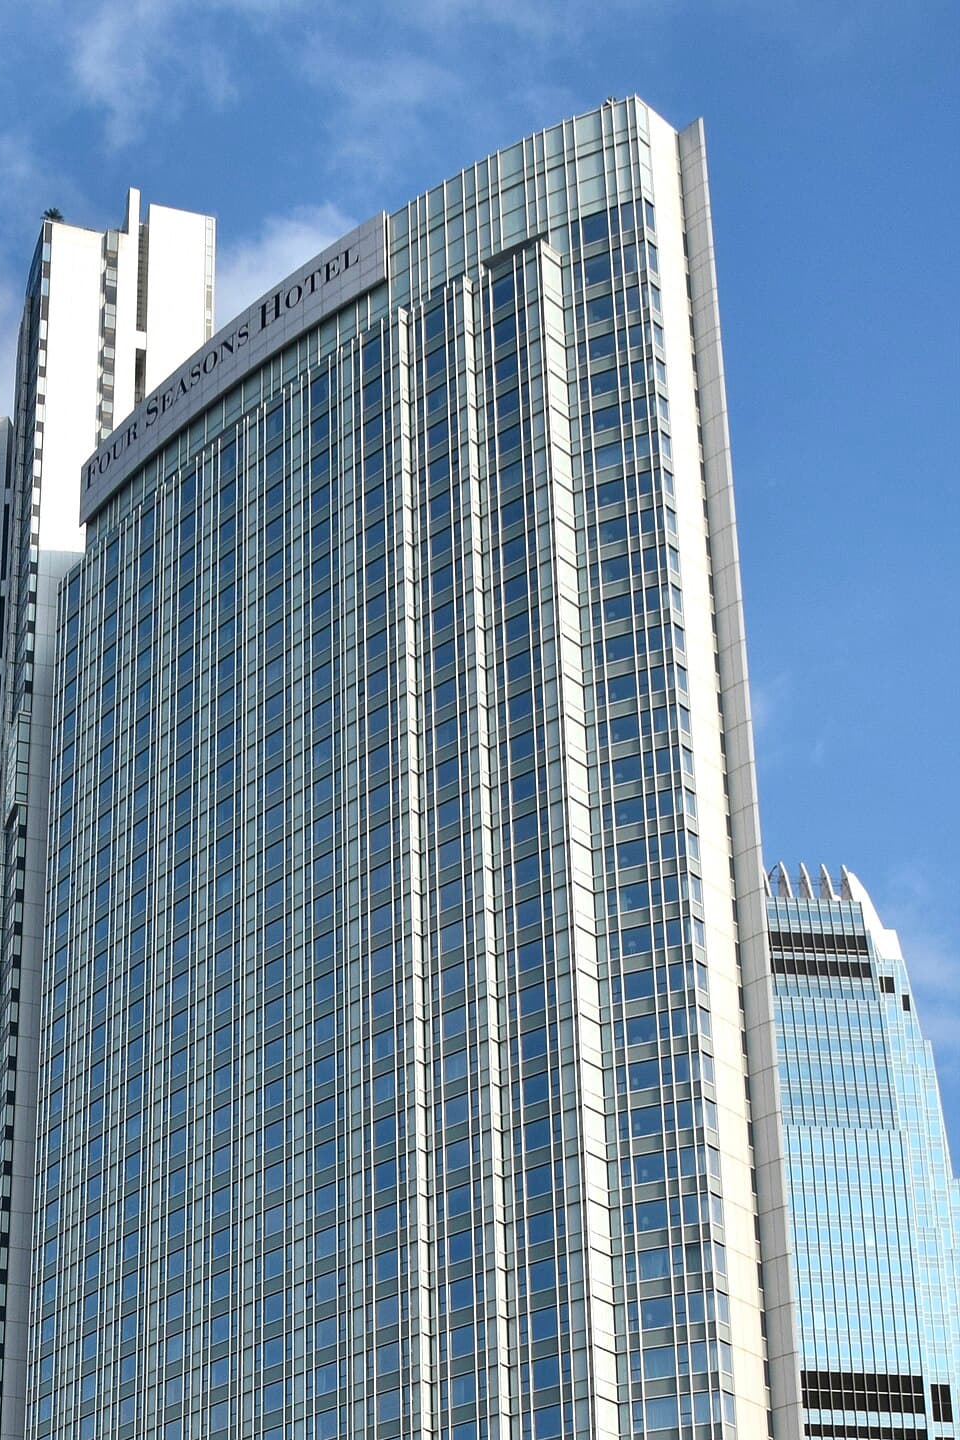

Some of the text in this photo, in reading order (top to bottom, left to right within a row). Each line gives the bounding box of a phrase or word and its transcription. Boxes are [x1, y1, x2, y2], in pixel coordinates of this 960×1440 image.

[86, 248, 360, 490] FOUR SEASONS HOTEL
